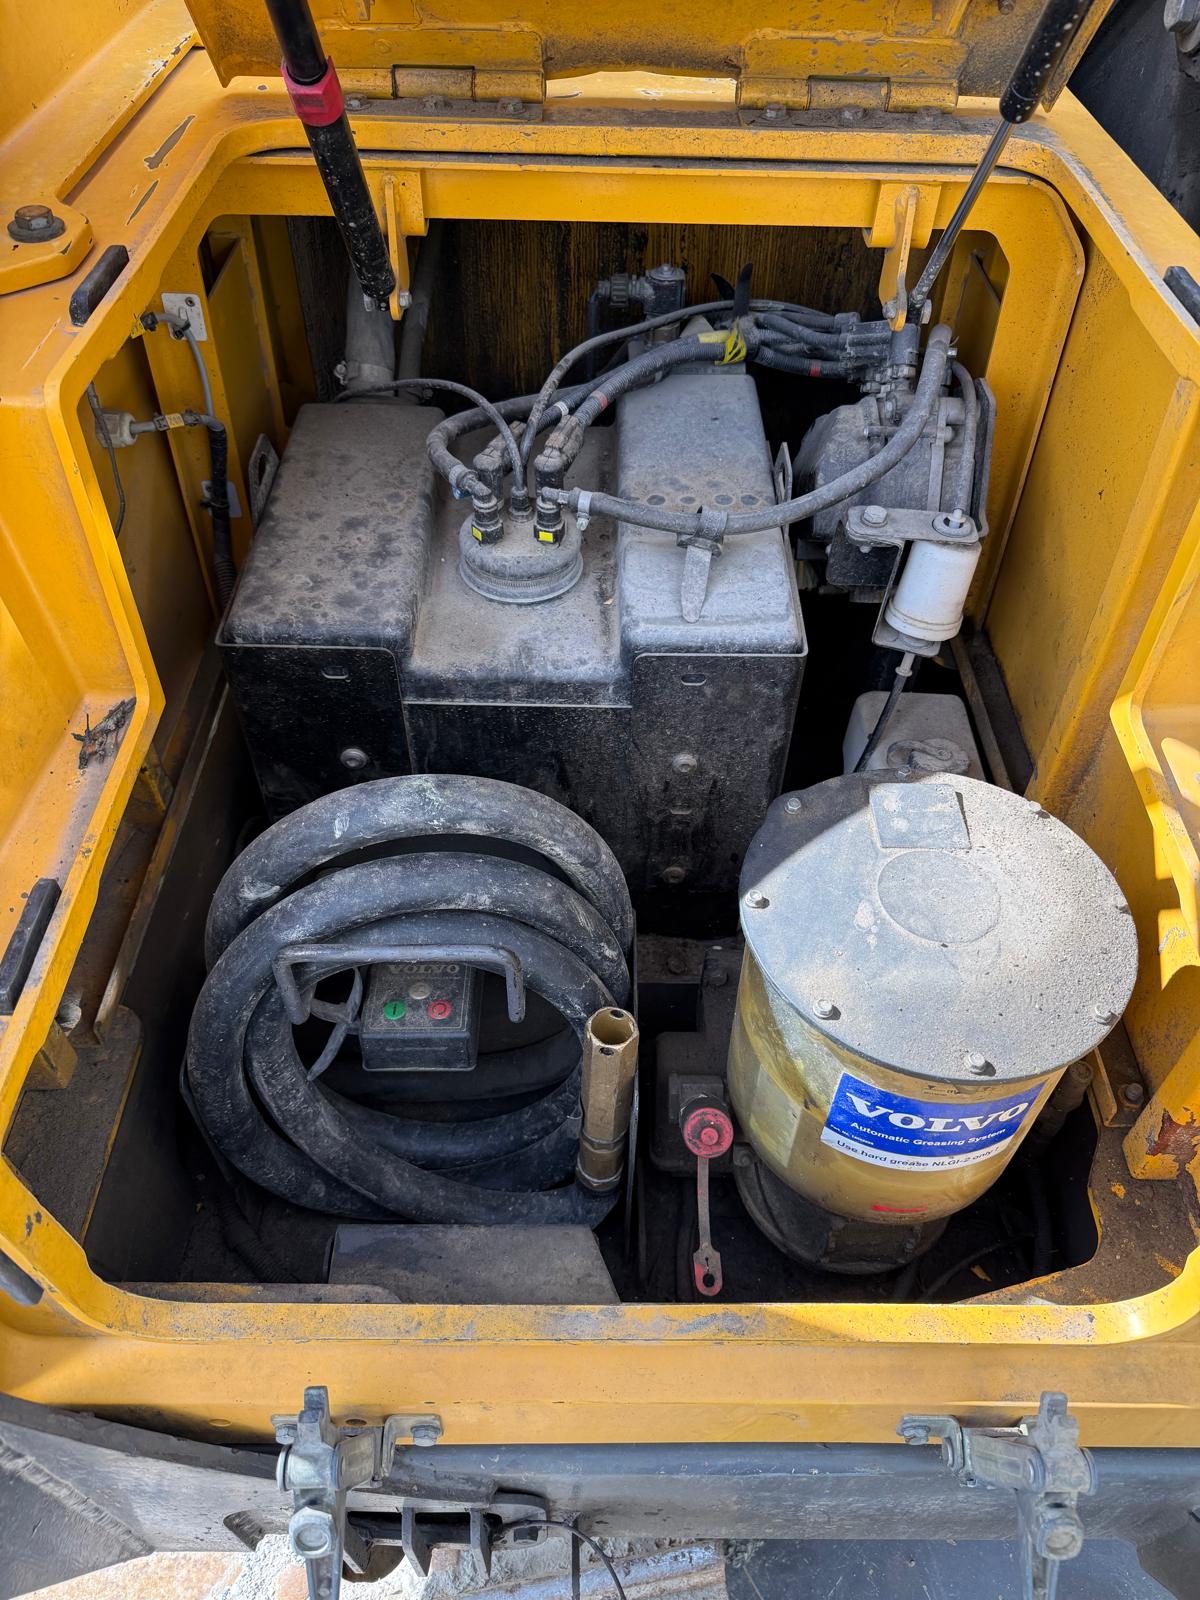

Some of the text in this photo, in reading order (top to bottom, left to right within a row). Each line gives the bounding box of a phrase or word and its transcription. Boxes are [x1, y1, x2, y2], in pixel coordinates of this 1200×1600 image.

[388, 964, 459, 974] VOLVO
[846, 1092, 1028, 1132] VOLVO
[850, 1122, 910, 1144] Automatic
[912, 1139, 966, 1147] Greasing
[967, 1128, 1006, 1143] System
[837, 1140, 858, 1153] Use
[860, 1150, 888, 1162] hard
[889, 1158, 929, 1167] grease
